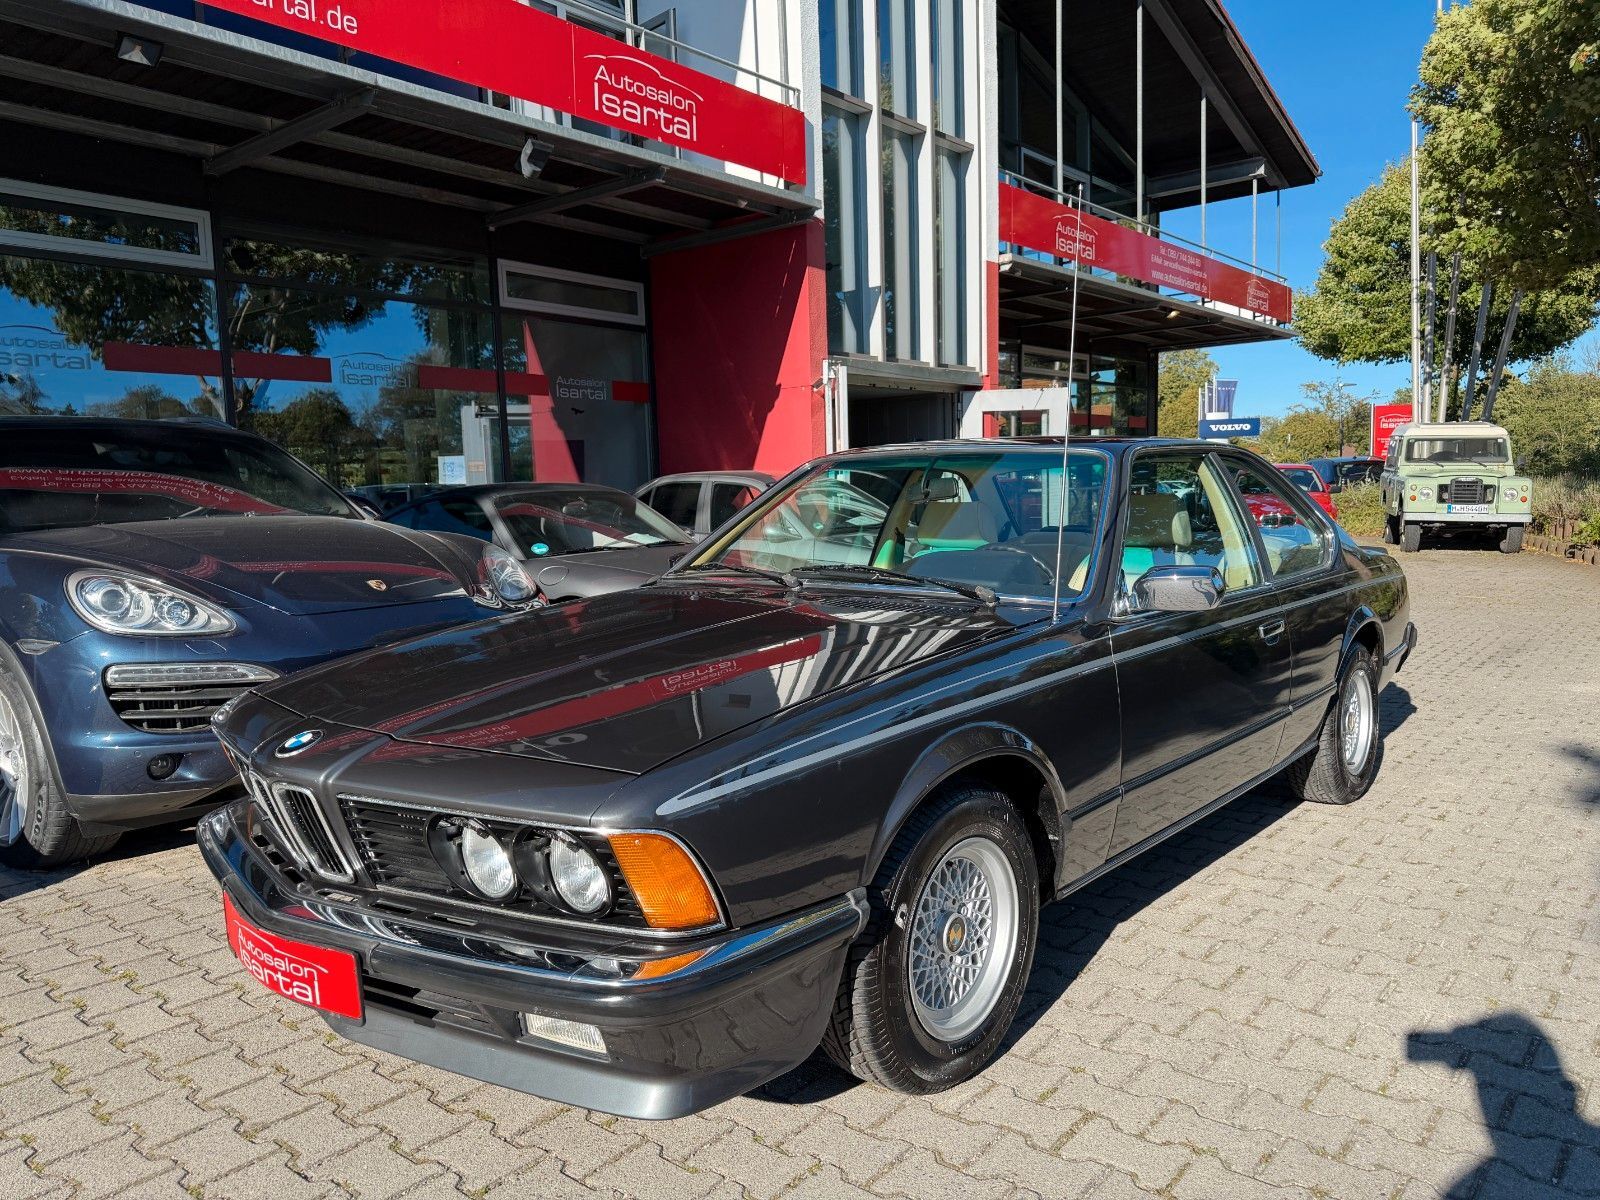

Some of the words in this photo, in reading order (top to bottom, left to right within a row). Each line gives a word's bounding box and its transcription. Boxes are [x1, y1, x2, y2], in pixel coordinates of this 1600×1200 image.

[594, 64, 696, 114] Autosalon
[593, 81, 697, 142] Isartal
[1055, 231, 1096, 261] Isartal
[1056, 221, 1096, 243] Autosalon
[556, 383, 607, 400] Isartal
[1209, 423, 1251, 431] VOLVO
[238, 927, 318, 980] Autosalon
[239, 941, 321, 1006] Isartal
